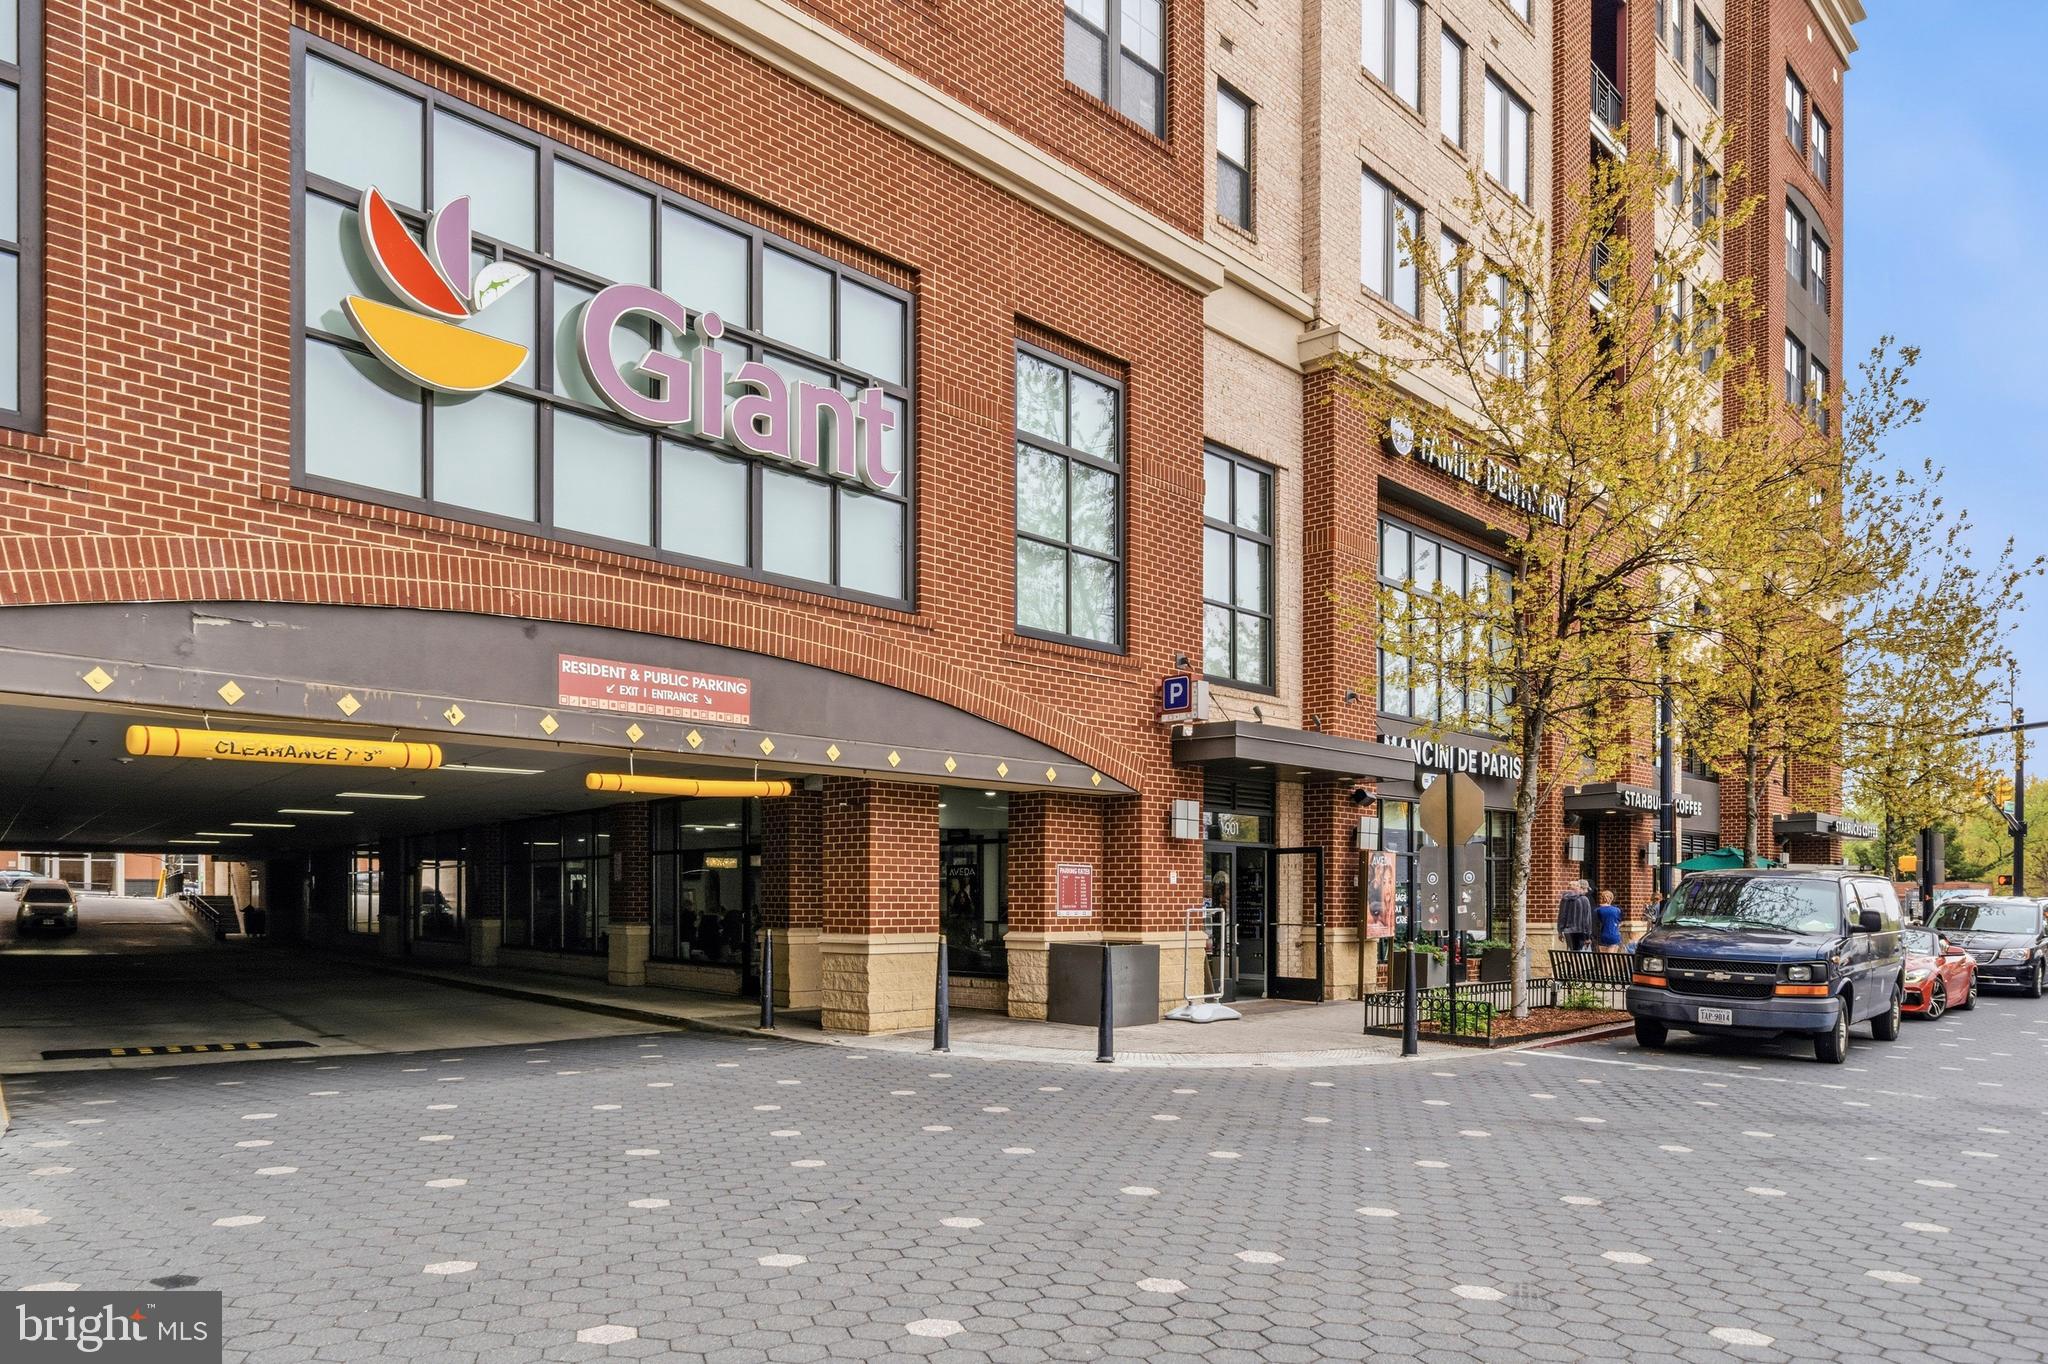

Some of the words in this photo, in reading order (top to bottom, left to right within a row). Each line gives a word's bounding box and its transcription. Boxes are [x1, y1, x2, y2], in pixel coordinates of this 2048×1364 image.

[578, 284, 901, 490] Giant
[562, 660, 627, 680] RESIDENT
[629, 669, 641, 682] &
[643, 671, 689, 687] PUBLIC
[692, 677, 748, 694] PARKING
[619, 685, 639, 697] EXIT
[651, 690, 699, 704] ENTRANCE
[1170, 682, 1184, 705] P
[1458, 748, 1478, 773] DE
[1481, 752, 1522, 780] PARIS
[1624, 790, 1661, 811] STARBU
[1675, 799, 1703, 816] COFFEE
[949, 867, 976, 876] AVEDA
